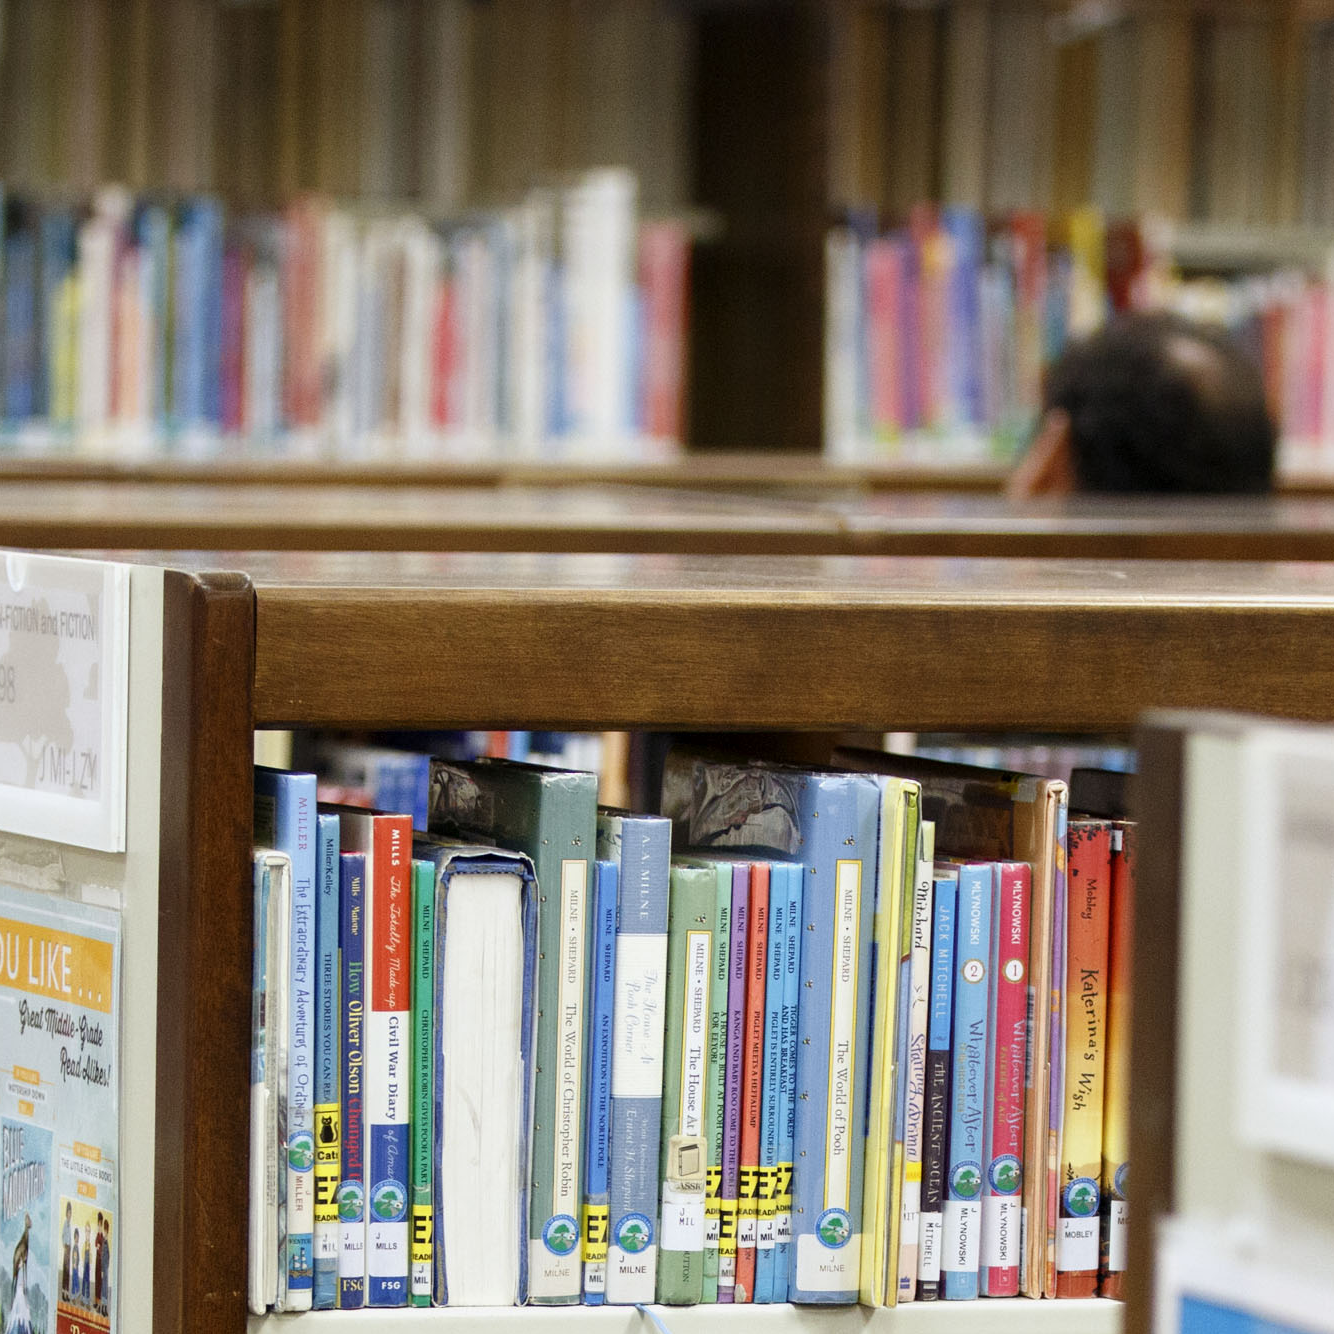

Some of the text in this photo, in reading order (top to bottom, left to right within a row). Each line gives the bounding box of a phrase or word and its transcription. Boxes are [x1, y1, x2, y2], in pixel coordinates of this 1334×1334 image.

[41, 613, 58, 636] and
[60, 611, 95, 641] FICTION
[298, 797, 308, 851] MILLER
[323, 838, 334, 896] Miller/Kelley
[391, 829, 400, 866] MILLS
[568, 889, 578, 984] MILNE SHEPARD
[914, 880, 929, 953] Mitchard
[970, 880, 982, 945] MLYNOWSKI
[1081, 878, 1098, 920] Mobley
[28, 937, 72, 994] LIKE
[293, 878, 311, 1129] The Extraordinary Adventures of Ordinary
[381, 876, 402, 1142] The Totally Made-up Civil War Diary of
[936, 905, 950, 1018] JACK MITCHELL
[19, 1000, 104, 1052] Great Middle-Grade
[323, 952, 332, 1079] THREE STORIES YOU CAN
[1072, 968, 1100, 1111] Katerina's Wish
[59, 1046, 82, 1083] Read
[346, 961, 363, 1168] How Oliver Olson Changed
[560, 1003, 577, 1197] The World of Christopher Robin
[833, 1040, 849, 1157] The World of Pooh
[965, 1019, 983, 1154] Whatever After
[928, 1062, 946, 1204] THE ANCIENT OCEAN
